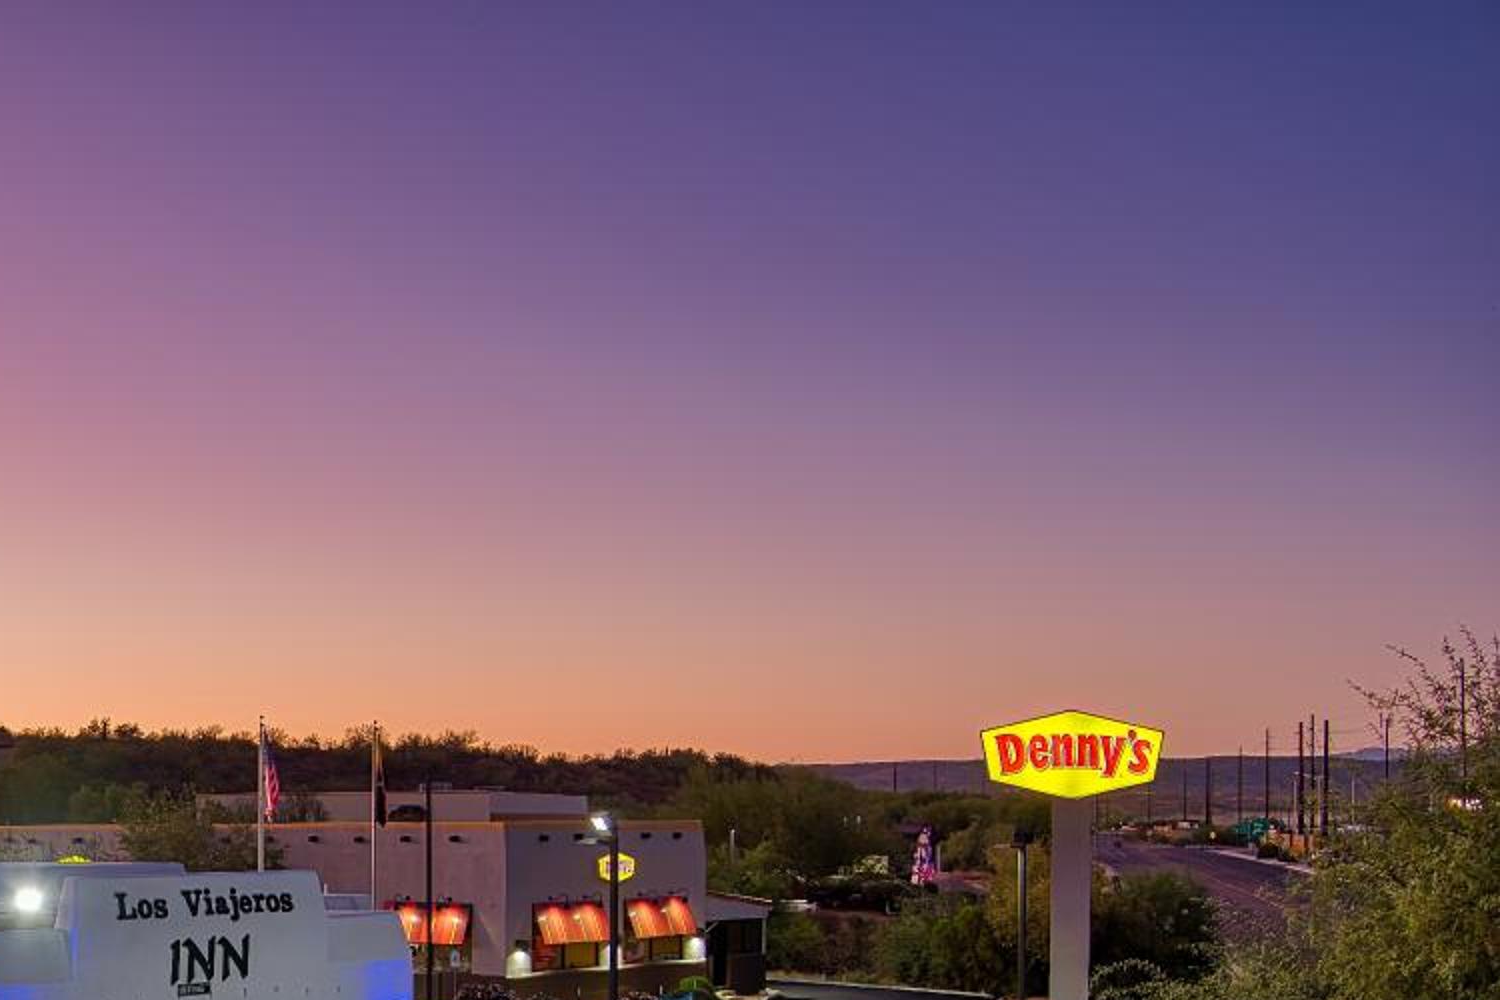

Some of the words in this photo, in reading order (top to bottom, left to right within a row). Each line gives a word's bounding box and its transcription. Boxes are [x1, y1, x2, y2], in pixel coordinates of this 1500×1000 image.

[995, 730, 1153, 778] Denny's
[114, 892, 169, 921] Los
[180, 887, 294, 921] Viajeros
[169, 932, 250, 986] INN
